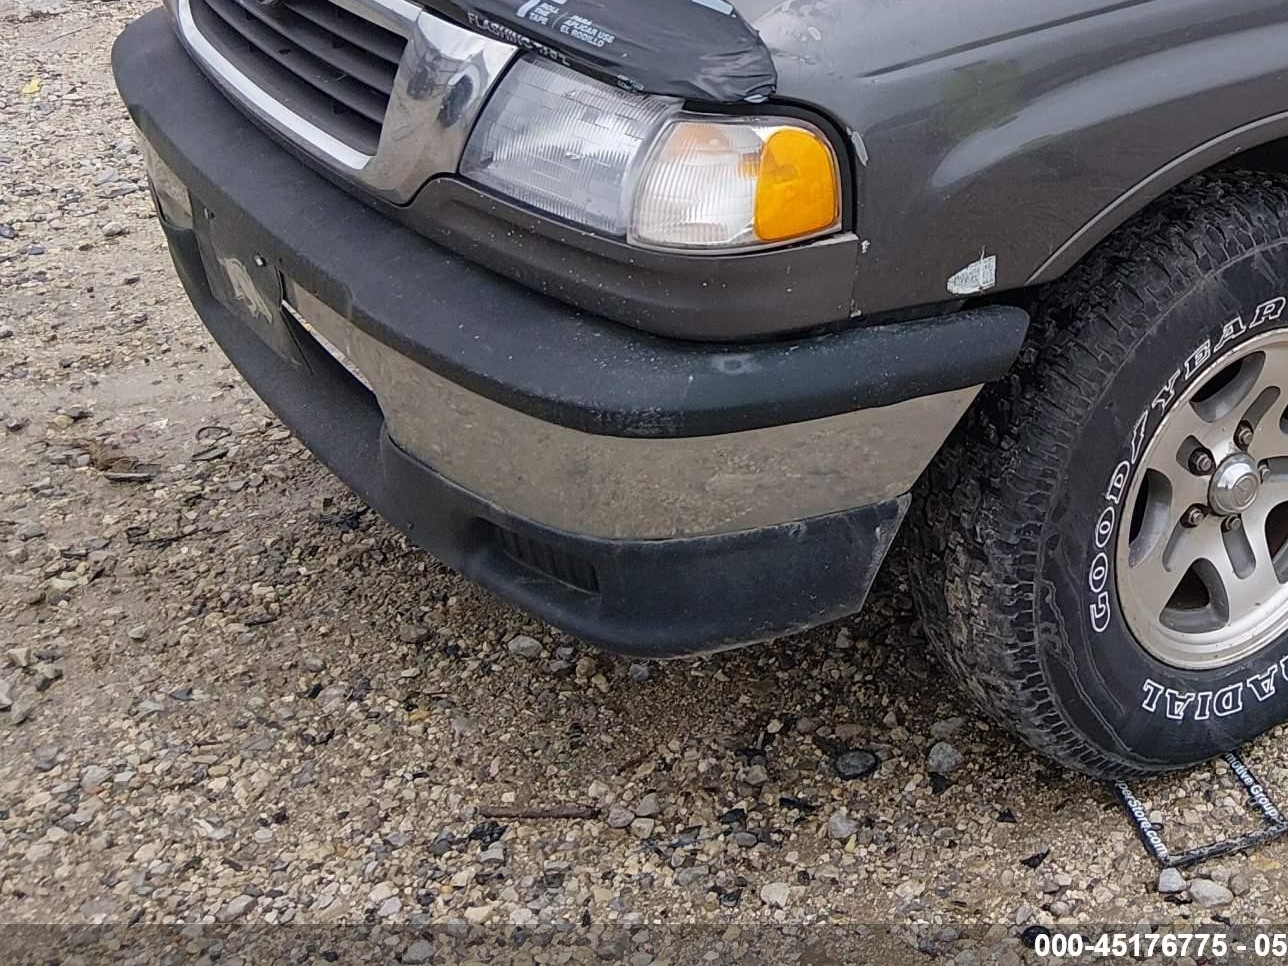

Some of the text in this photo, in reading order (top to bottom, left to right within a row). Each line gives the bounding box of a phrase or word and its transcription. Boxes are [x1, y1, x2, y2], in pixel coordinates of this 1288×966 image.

[529, 12, 549, 26] TAPE
[560, 24, 605, 48] EL RODILLO
[563, 19, 616, 44] APLICAR USE
[1250, 784, 1279, 820] Group
